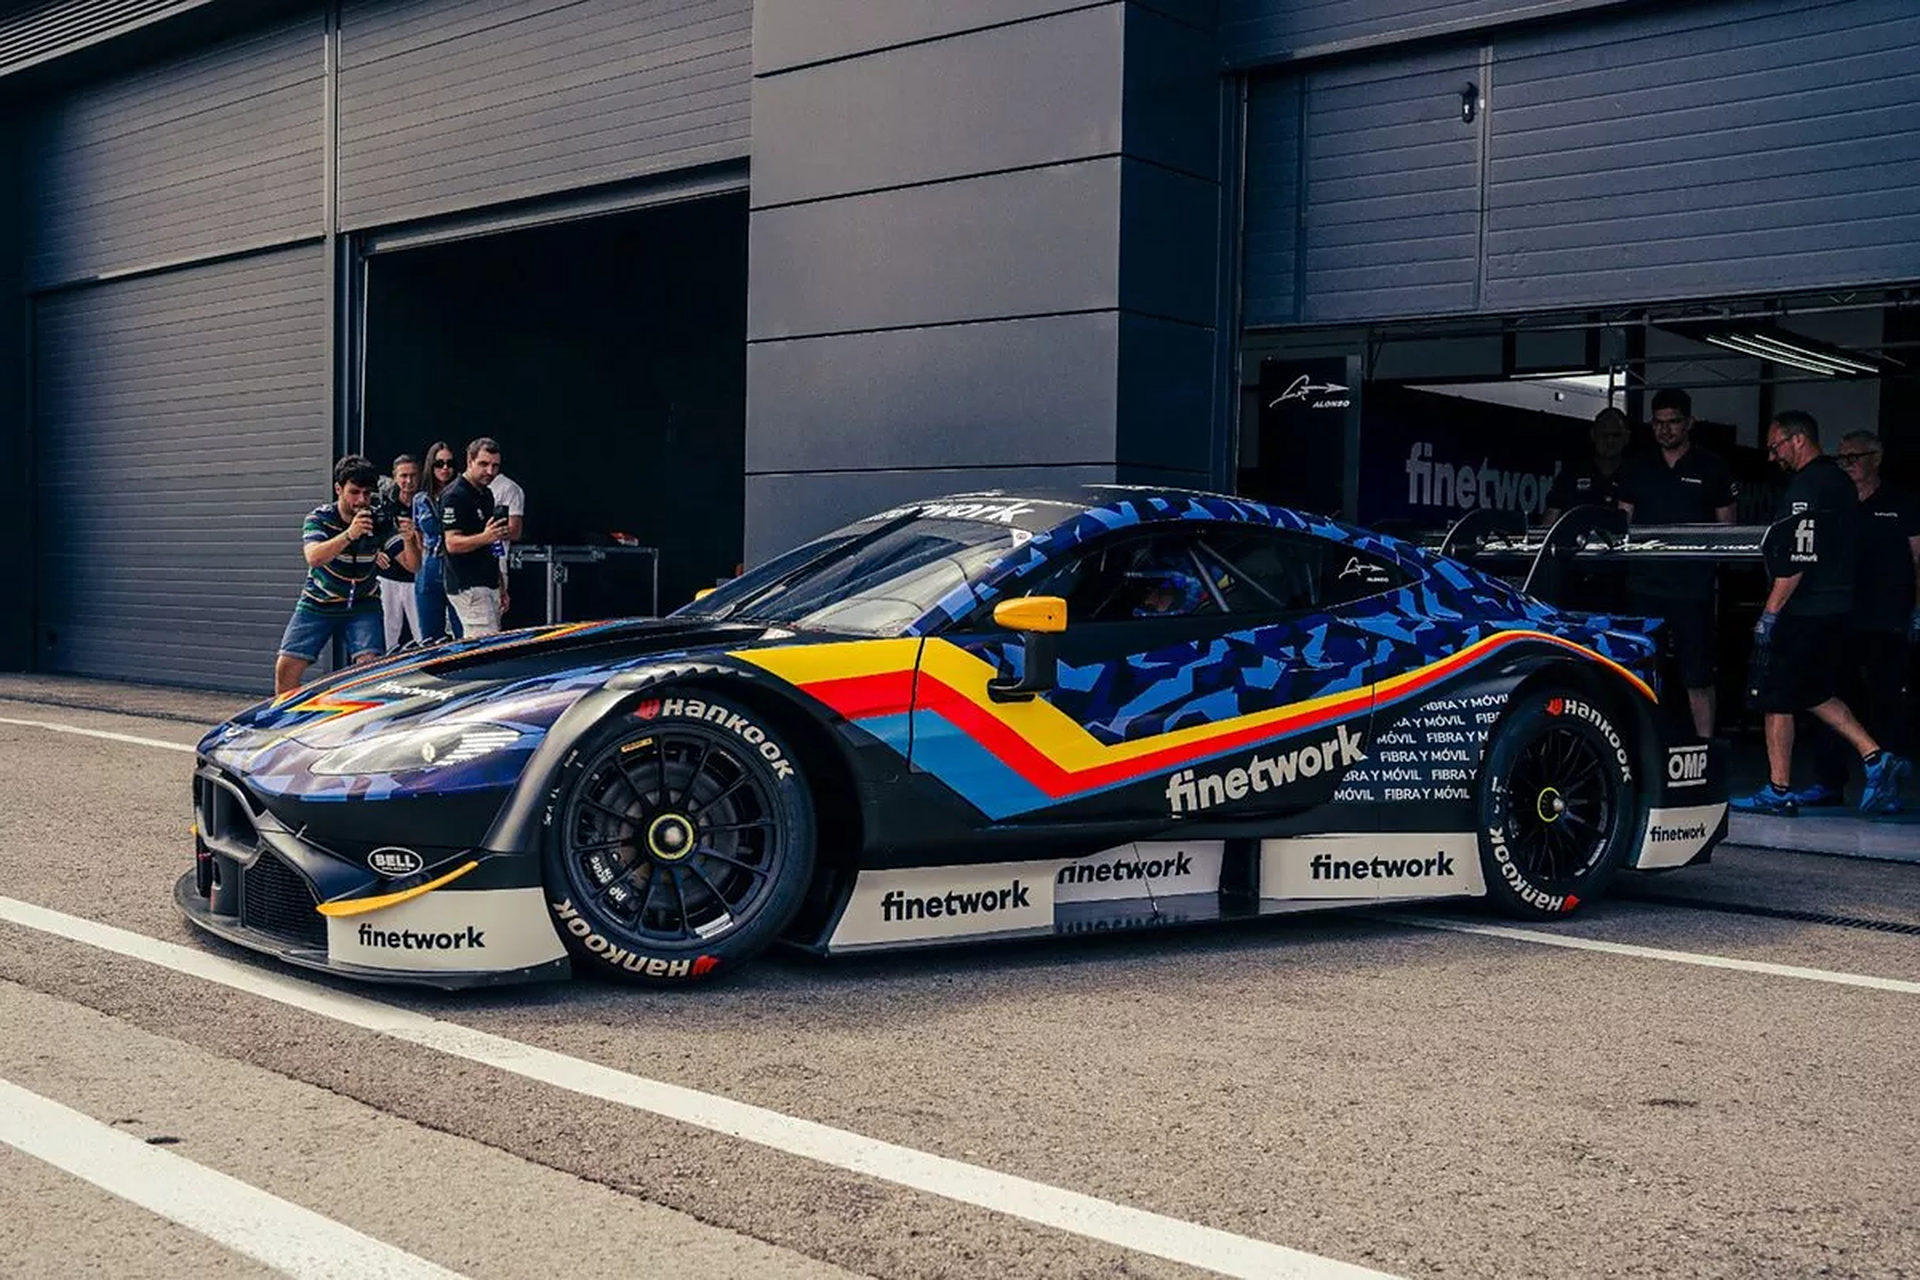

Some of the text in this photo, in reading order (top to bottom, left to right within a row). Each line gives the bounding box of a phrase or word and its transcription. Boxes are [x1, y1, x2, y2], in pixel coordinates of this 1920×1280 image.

[1405, 442, 1562, 515] finetwor
[1459, 699, 1468, 708] Y
[1413, 717, 1422, 728] Y
[1424, 714, 1466, 727] MÓVIL
[1377, 730, 1417, 745] MÓVIL
[1426, 731, 1465, 744] FIBRA
[1466, 731, 1475, 742] Y
[1380, 750, 1418, 763] FIBRA
[1419, 750, 1428, 762] Y
[1431, 747, 1470, 761] MÓVIL
[1164, 724, 1368, 819] finetwork
[1370, 769, 1380, 781] Y
[1382, 766, 1422, 781] MÓVIL
[1431, 768, 1467, 780] FIBRA
[1468, 768, 1478, 780] Y
[1668, 753, 1707, 780] OMP
[1334, 784, 1470, 801] MÓVIL FIBRA Y MÓVIL
[1650, 823, 1707, 842] finetwork
[374, 854, 415, 868] BELL
[1311, 850, 1454, 880] finetwork
[881, 880, 1030, 922] finetwork
[358, 923, 486, 949] finetwork
